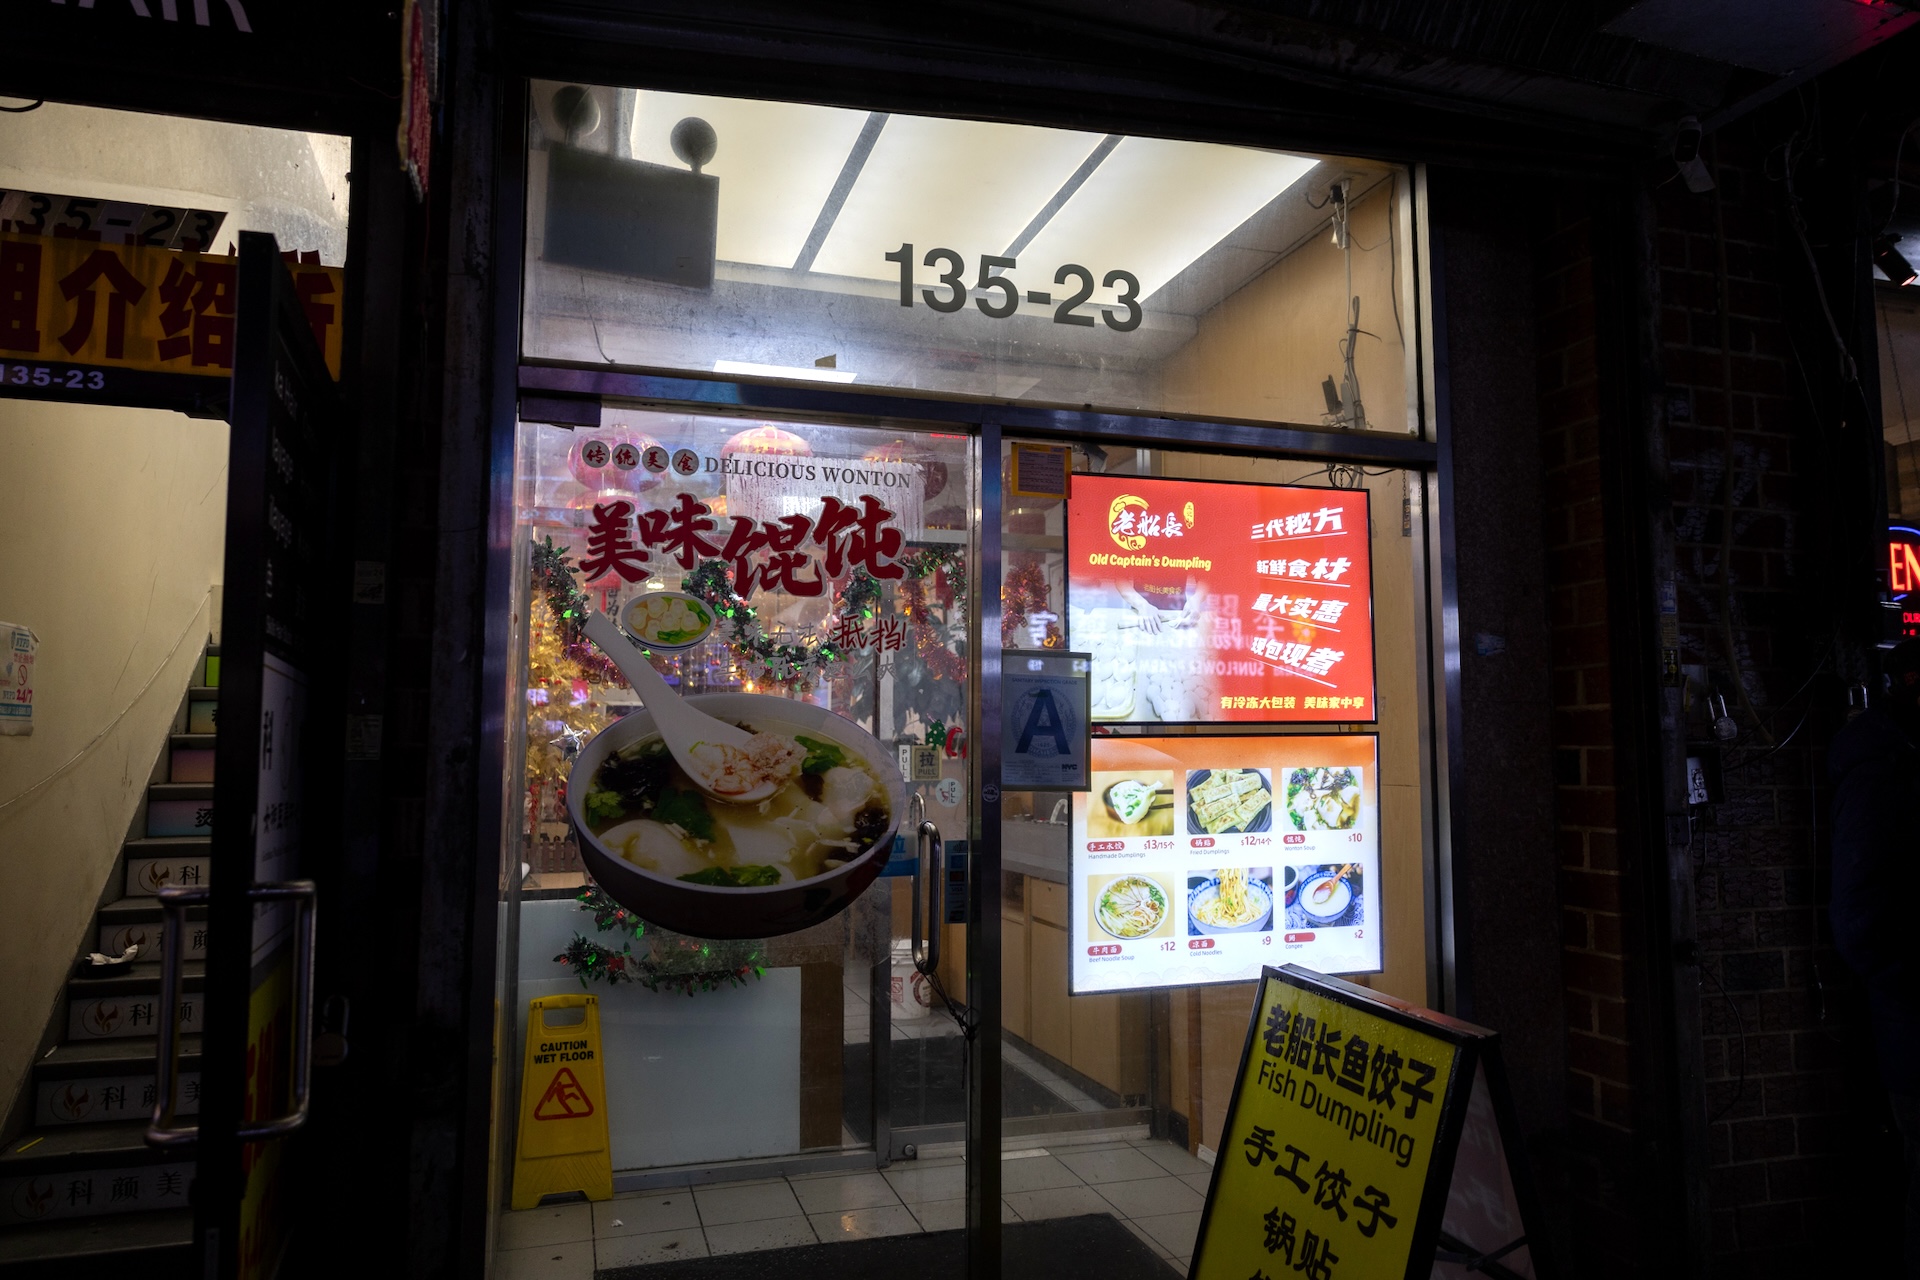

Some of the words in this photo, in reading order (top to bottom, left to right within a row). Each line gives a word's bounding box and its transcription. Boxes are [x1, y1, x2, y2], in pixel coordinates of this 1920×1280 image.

[0, 191, 215, 250] 35-23
[885, 243, 1143, 332] 135-23
[585, 444, 696, 473] 传统美食
[705, 456, 816, 481] DELICIOUS
[822, 466, 911, 488] WONTON
[1251, 507, 1344, 540] 三代秘方
[579, 493, 908, 600] 美味馄饨
[1089, 552, 1108, 566] Old
[1109, 553, 1160, 569] Captain's
[1161, 556, 1212, 571] Dumpling
[1256, 557, 1350, 581] 新鲜食材
[1251, 592, 1348, 624] 量大实惠
[1251, 635, 1345, 676] 现包现煮
[1220, 696, 1296, 709] 有冷冻大包装
[1303, 696, 1364, 709] 美味家中享
[1015, 689, 1071, 754] A
[918, 768, 937, 776] PULL
[919, 752, 935, 768] 拉
[1088, 841, 1123, 851] 手工水饺
[1195, 838, 1212, 847] 锅贴
[1348, 833, 1362, 843] $10
[1160, 941, 1176, 951] $12
[1262, 936, 1272, 945] $9
[1354, 929, 1363, 939] $2
[1092, 945, 1118, 954] 牛肉面
[534, 1053, 556, 1064] WET
[560, 1051, 594, 1062] FLOOR
[540, 1040, 588, 1052] CAUTION
[1262, 1003, 1437, 1120] 老船长鱼饺子
[1258, 1059, 1297, 1102] Fish
[1300, 1080, 1416, 1169] Dumpling
[67, 1171, 183, 1207] 科颜美
[1243, 1125, 1398, 1238] 手工饺子
[1263, 1206, 1340, 1280] 锅贴
